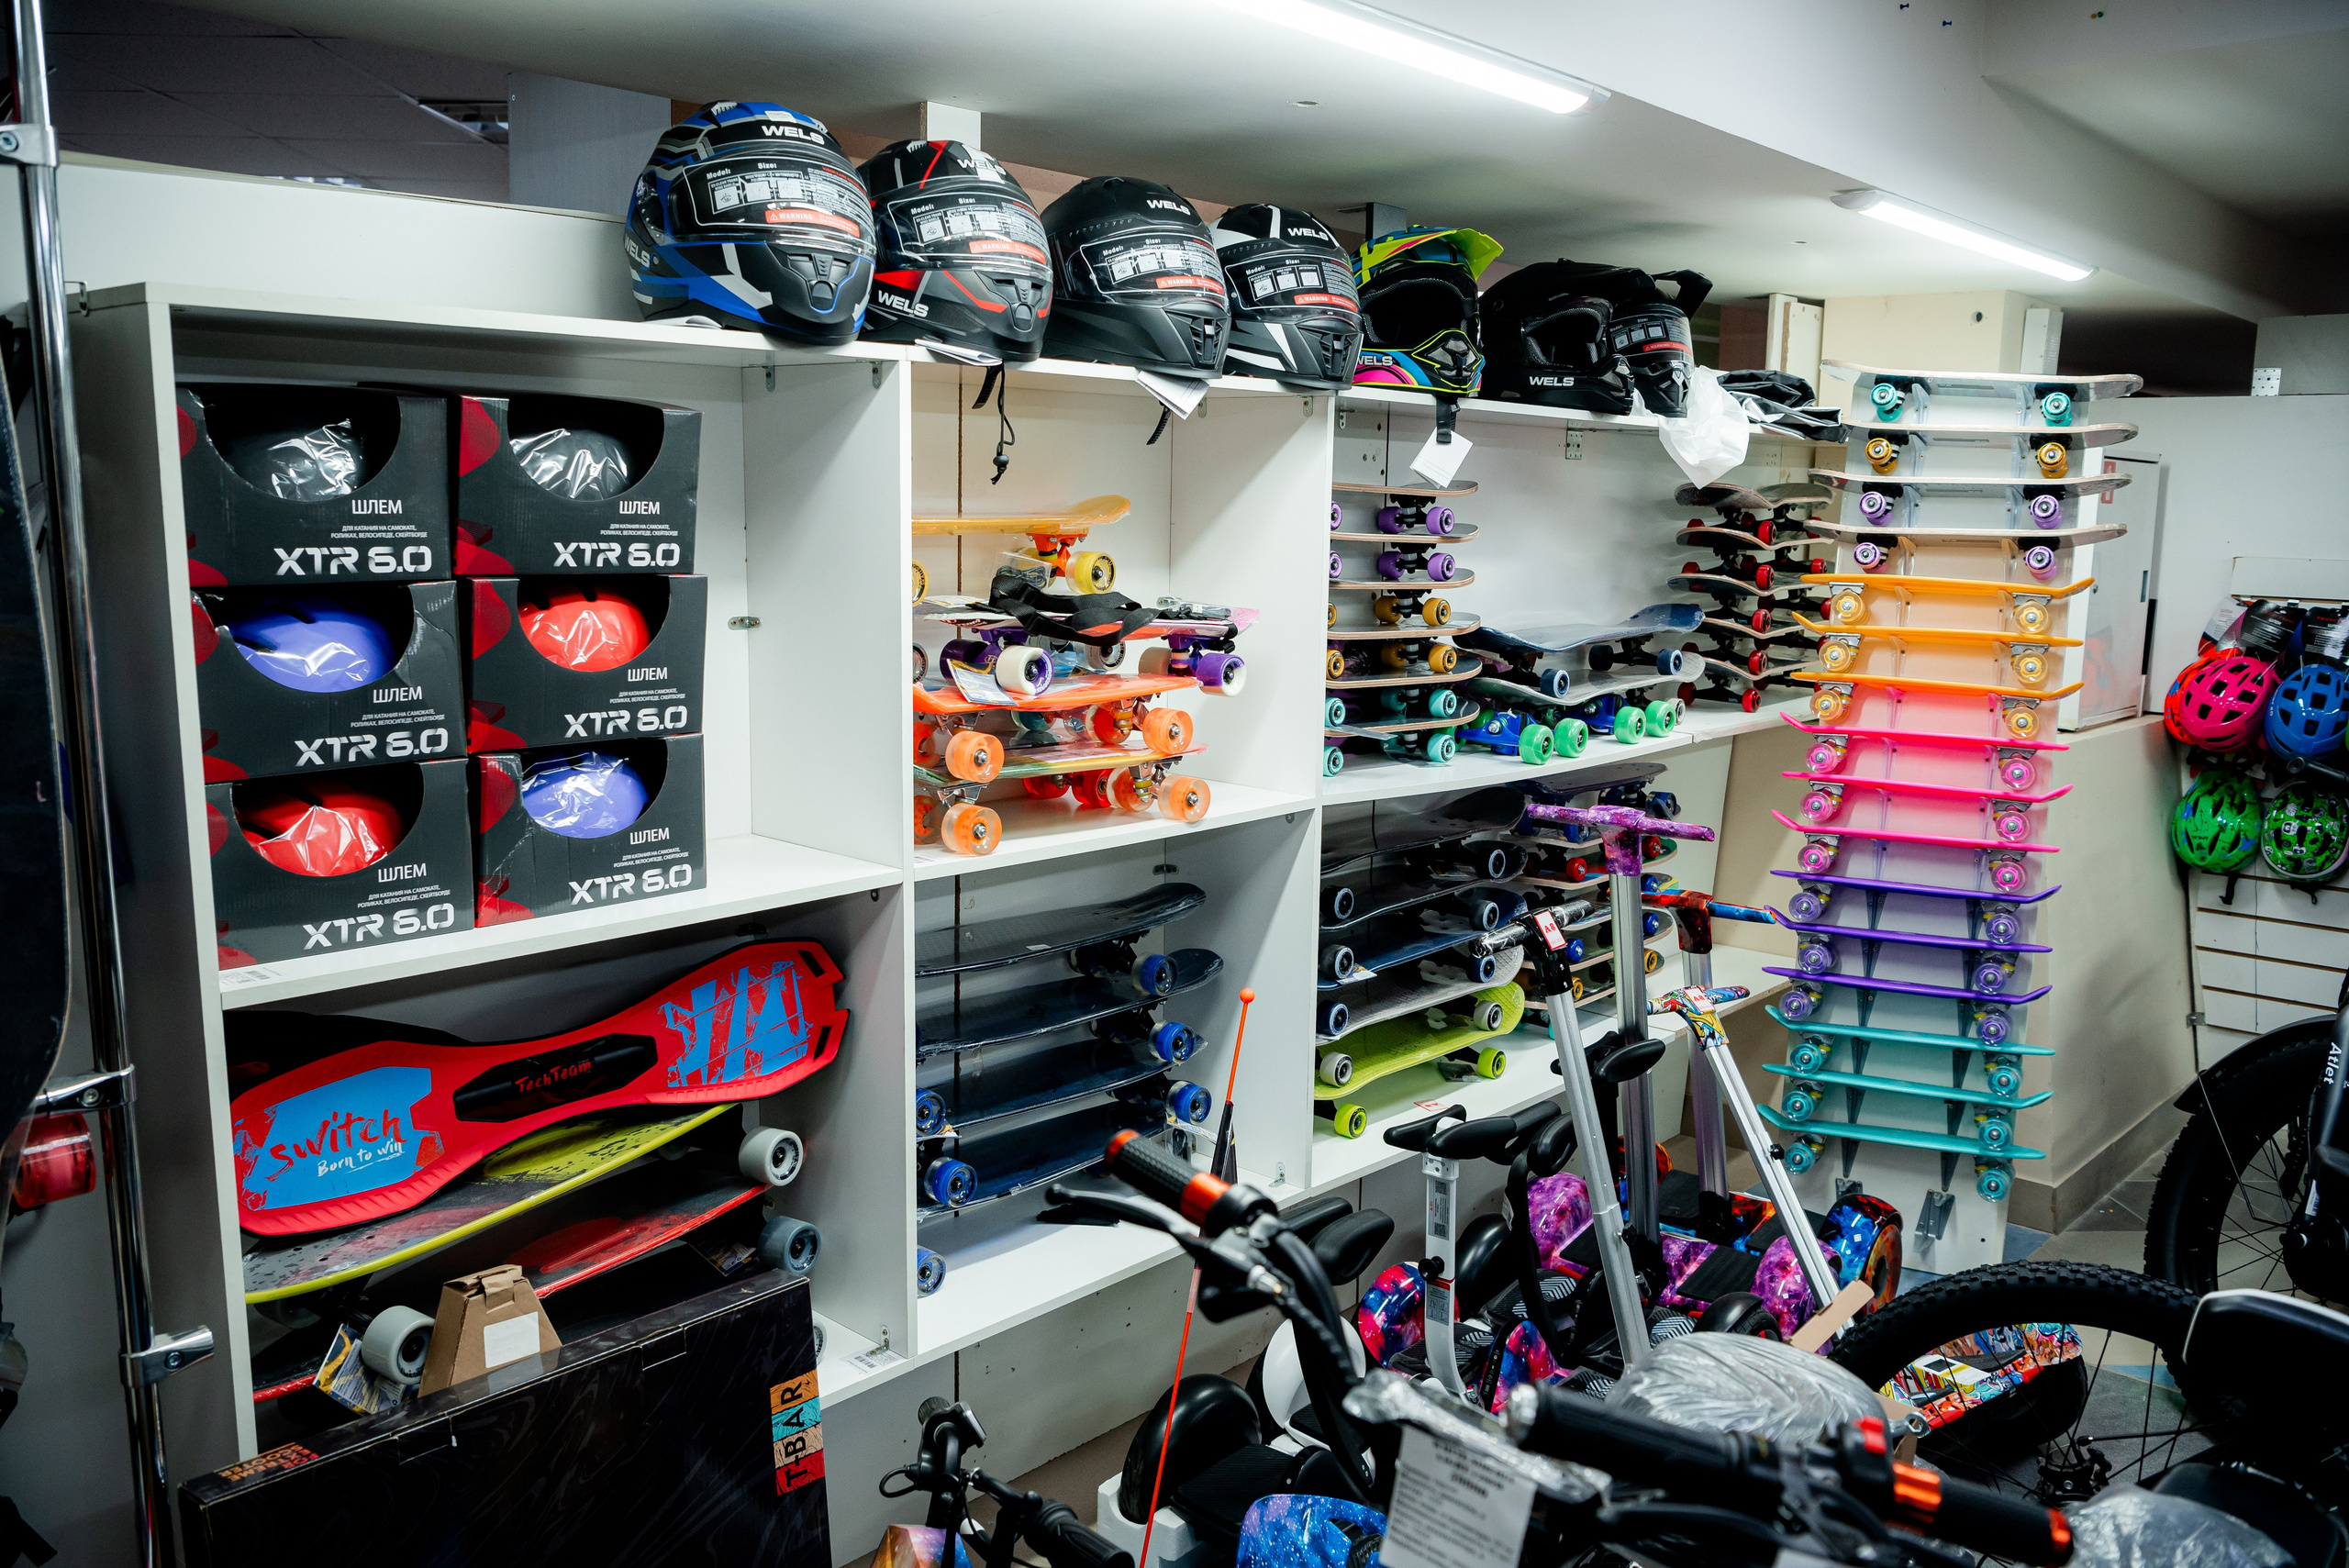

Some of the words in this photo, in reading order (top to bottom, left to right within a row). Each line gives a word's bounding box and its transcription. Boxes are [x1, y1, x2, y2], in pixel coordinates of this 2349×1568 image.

[762, 126, 825, 145] WELS
[707, 168, 731, 180] Model:
[957, 159, 1007, 175] WELS
[910, 204, 934, 215] Model:
[1147, 200, 1191, 216] WELS
[1287, 228, 1329, 240] WELS
[624, 233, 650, 268] WELS
[1102, 245, 1124, 256] Model:
[1245, 265, 1265, 275] Model:
[877, 290, 929, 317] WELS
[1530, 376, 1575, 386] WELS
[352, 499, 403, 514] ШЛЕМ
[619, 501, 660, 515] ШЛЕМ
[273, 547, 359, 575] XTR
[368, 546, 431, 573] 6.0
[553, 542, 622, 567] XTR
[628, 542, 681, 567] 6.0
[628, 667, 668, 682] ШЛЕМ
[373, 686, 423, 703] ШЛЕМ
[564, 710, 630, 738] XTR
[637, 706, 687, 731] 6.0
[294, 734, 377, 767] XTR
[385, 728, 448, 758] 6.0
[629, 828, 670, 845] ШЛЕМ
[378, 863, 427, 883] ШЛЕМ
[569, 873, 636, 906] XTR
[642, 863, 692, 893] 6.0
[303, 914, 384, 951] XTR
[393, 903, 455, 936] 6.0
[1544, 923, 1556, 934] A8
[2323, 1042, 2342, 1084] Atlet
[515, 1062, 591, 1092] TechTeam
[317, 1154, 356, 1177] Born
[357, 1149, 372, 1162] to
[377, 1138, 405, 1156] win
[781, 1381, 807, 1487] T-BAR
[218, 1444, 303, 1477] SCOOTER
[228, 1449, 311, 1482] EXTREME
[281, 1452, 319, 1469] FOR
